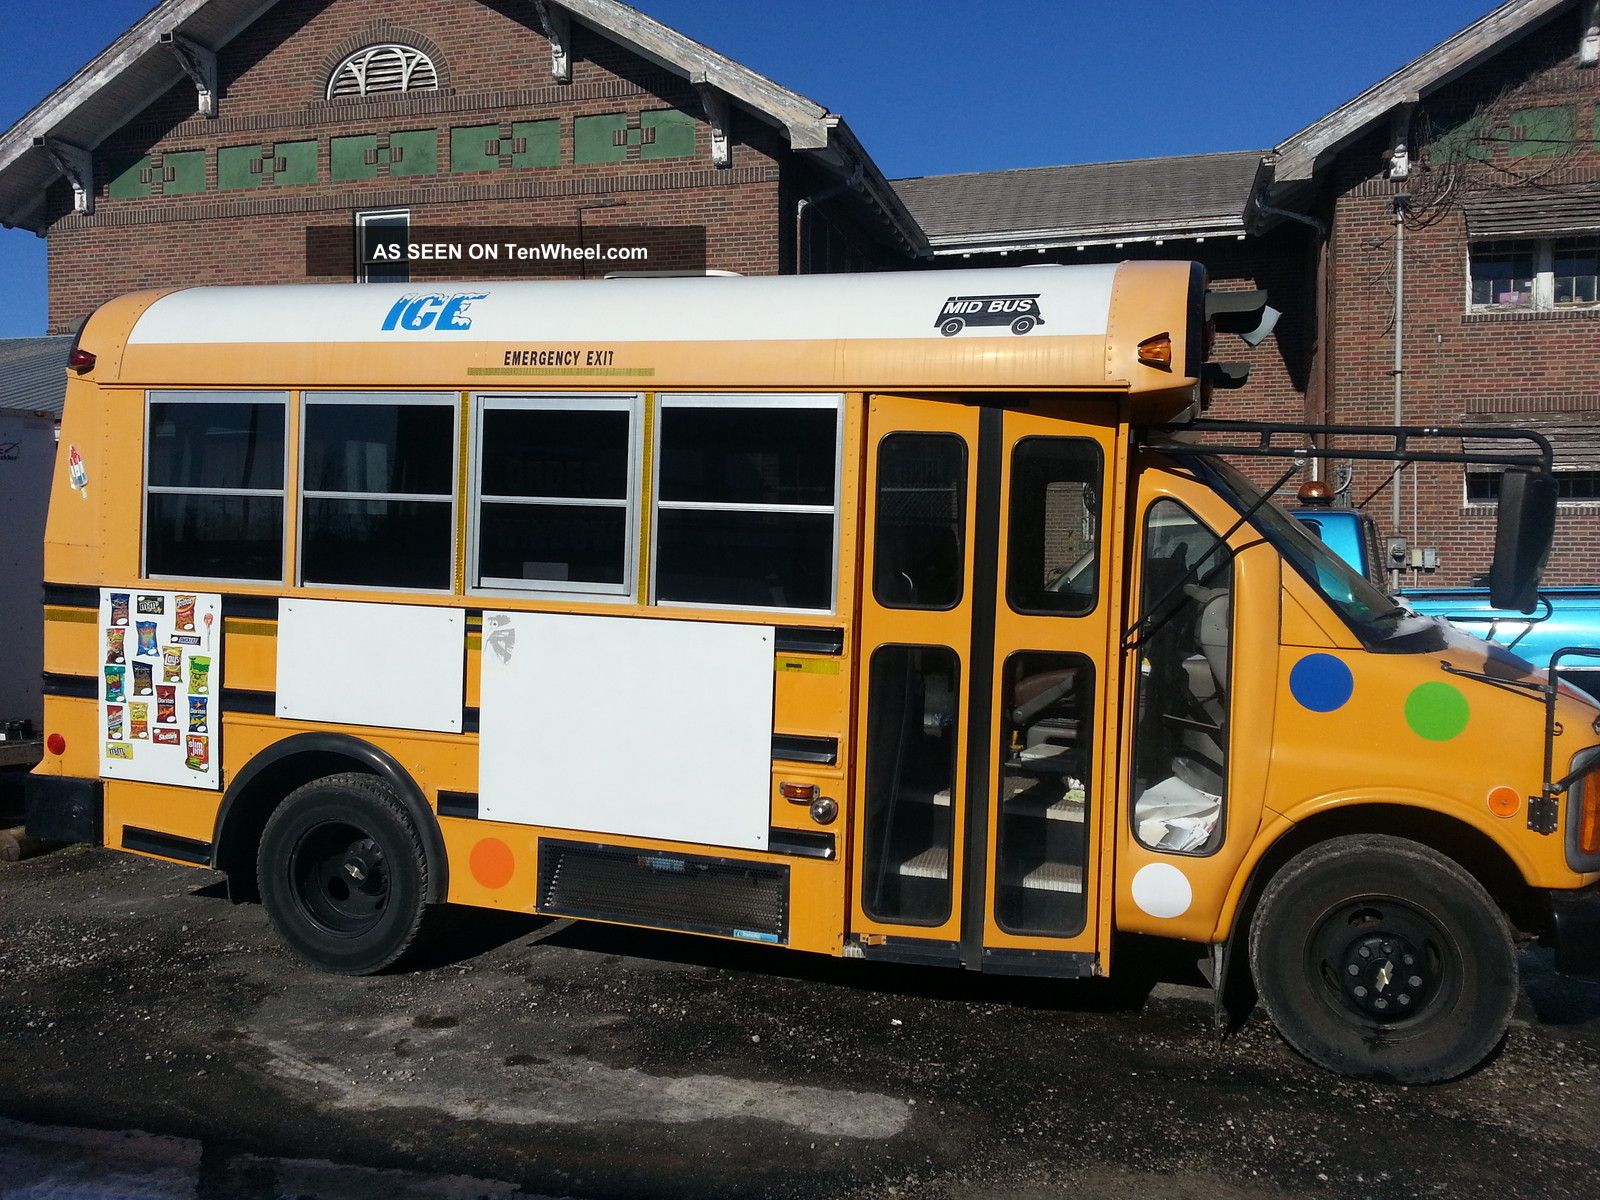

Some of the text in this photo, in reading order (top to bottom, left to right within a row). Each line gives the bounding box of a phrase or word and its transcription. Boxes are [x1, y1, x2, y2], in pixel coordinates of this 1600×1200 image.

[381, 292, 490, 331] ICE
[943, 300, 1033, 314] MID BUS
[504, 351, 614, 366] EMERGENCY EXIT
